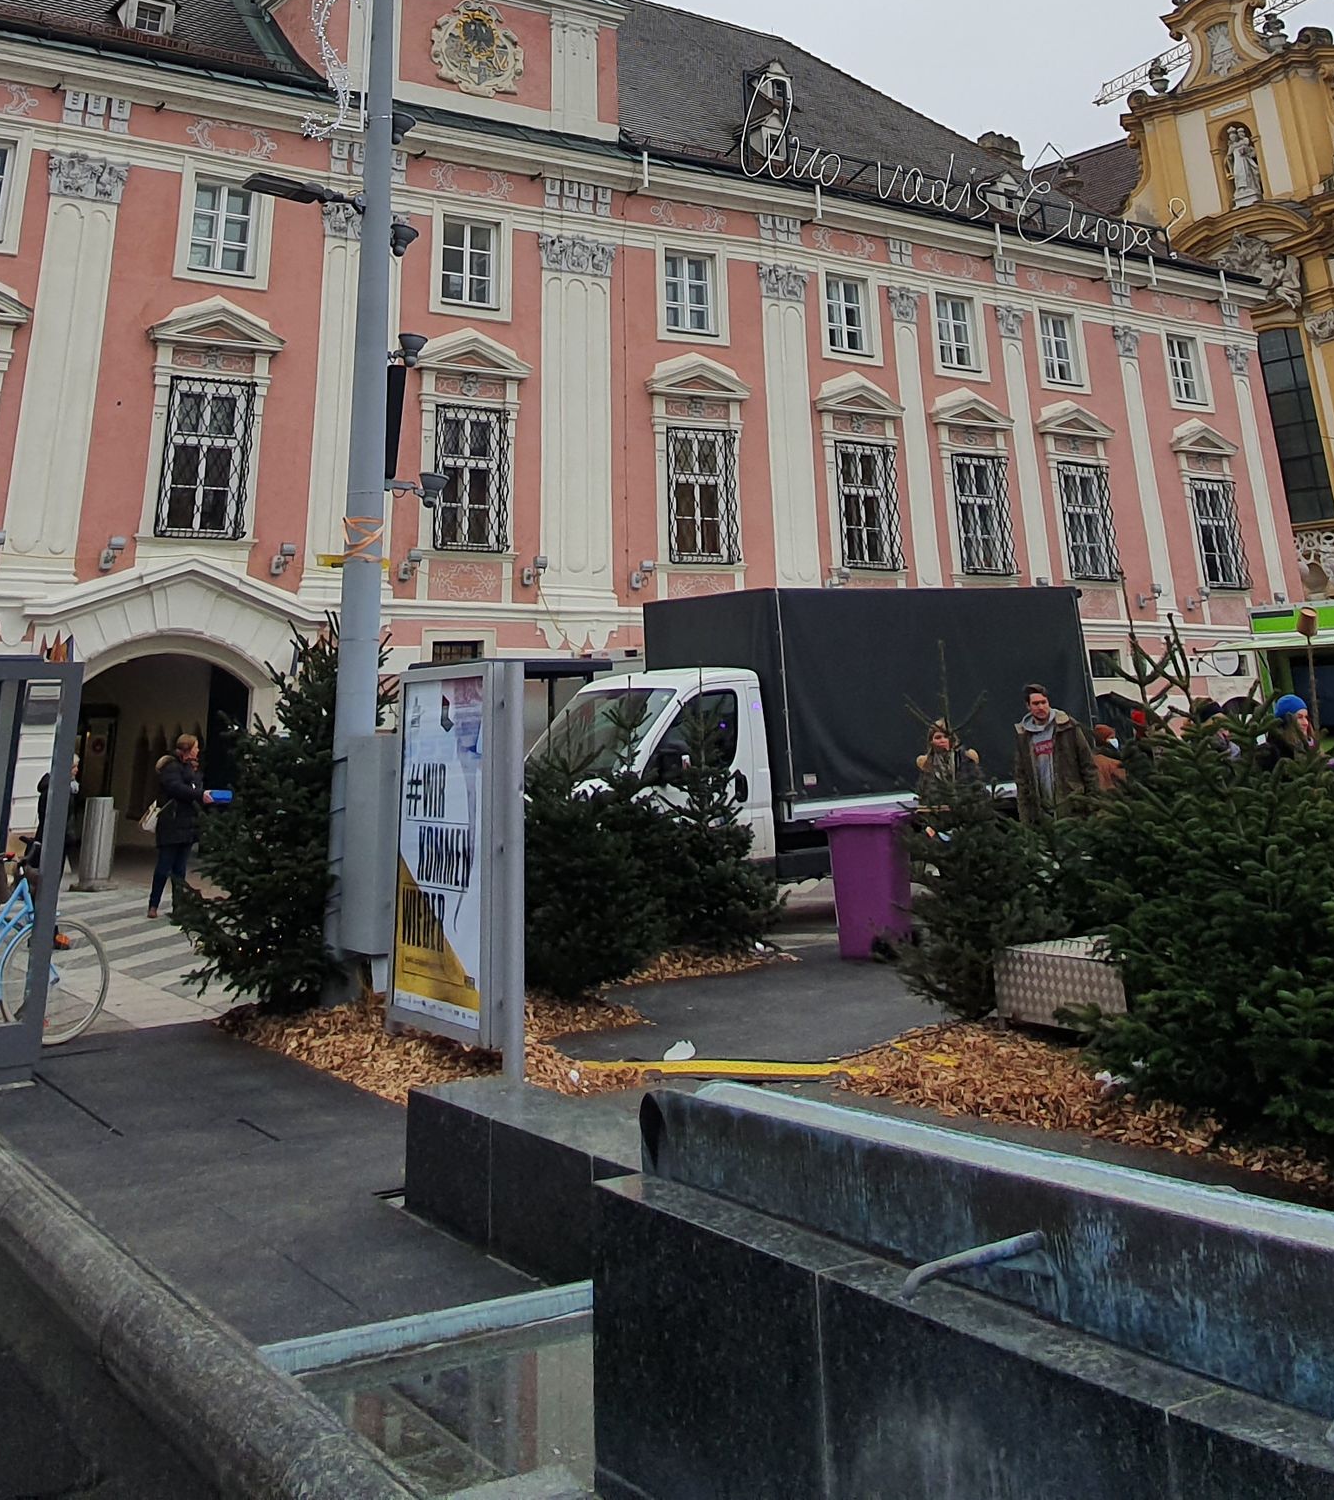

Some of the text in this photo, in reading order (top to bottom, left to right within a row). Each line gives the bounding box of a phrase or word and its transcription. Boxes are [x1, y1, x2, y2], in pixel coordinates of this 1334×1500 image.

[740, 75, 842, 187] Quo
[875, 153, 992, 220] vadis
[406, 763, 447, 818] #WIR
[417, 825, 471, 888] KOMMEN
[402, 888, 445, 952] WIEDER
